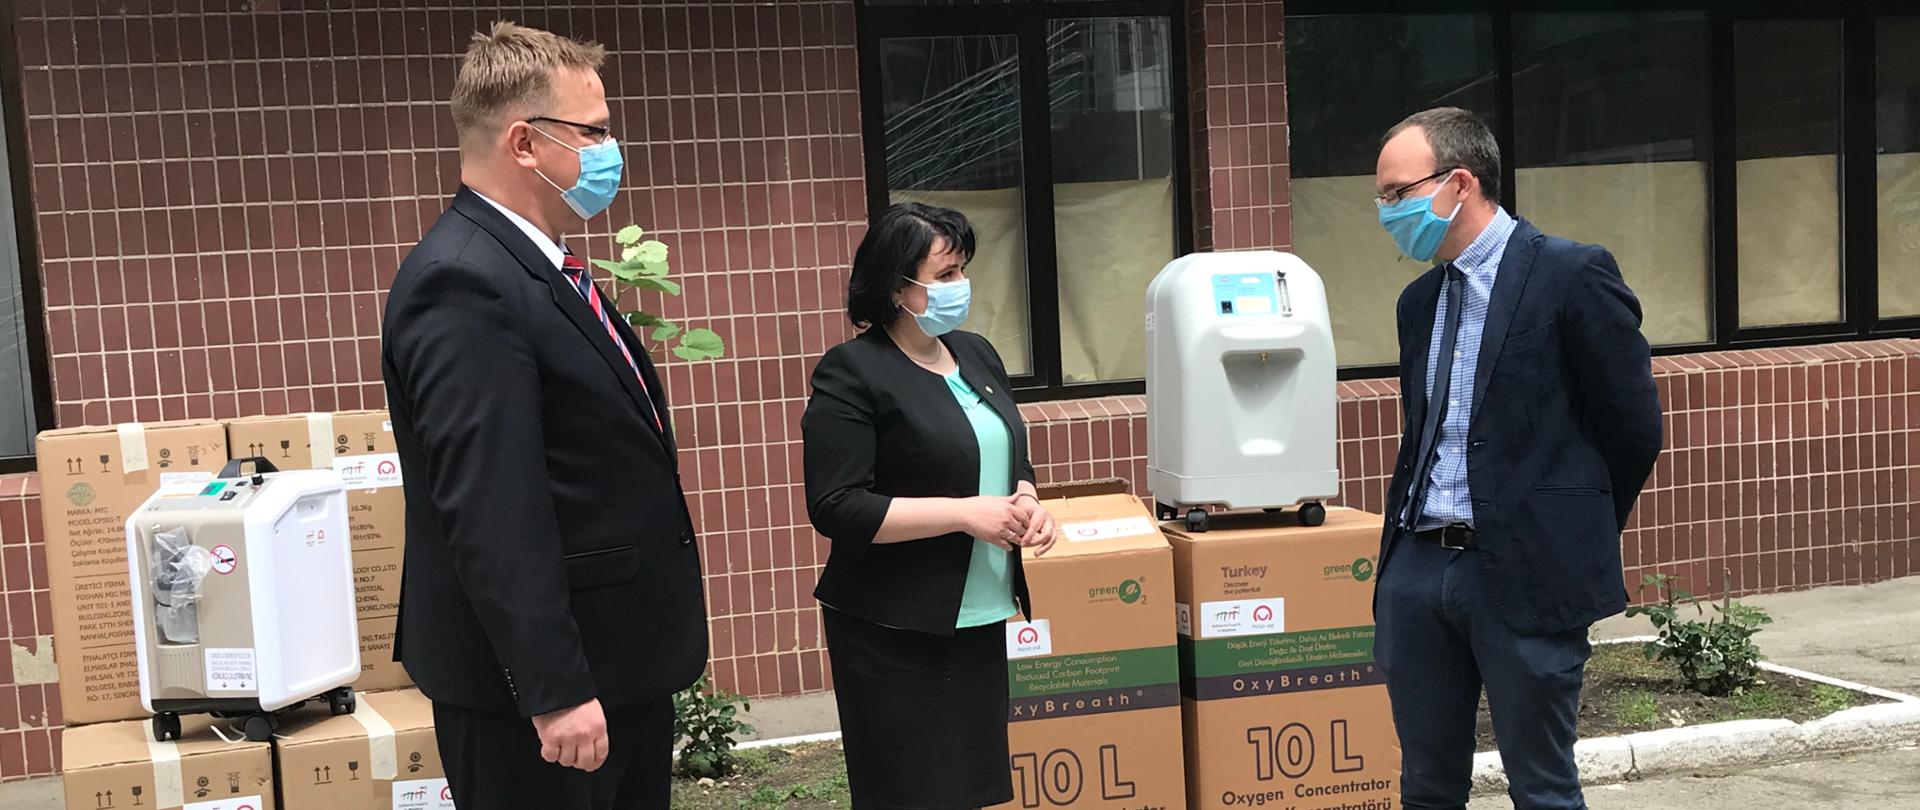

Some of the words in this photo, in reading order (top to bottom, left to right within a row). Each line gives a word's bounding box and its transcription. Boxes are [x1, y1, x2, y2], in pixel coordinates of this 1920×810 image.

[1221, 565, 1267, 579] Turkey
[1324, 564, 1351, 576] green
[1088, 586, 1119, 598] green
[1234, 586, 1261, 595] potential
[80, 623, 97, 631] PARK
[1017, 661, 1033, 671] Low
[1035, 660, 1062, 670] Energy
[1064, 654, 1118, 668] Consumption
[1015, 672, 1050, 682] Reduced
[1052, 668, 1083, 679] Carbon
[1085, 665, 1120, 676] Footprint
[1233, 669, 1360, 692] OxyBreath
[1029, 680, 1070, 692] Recyclable
[1072, 676, 1108, 687] Materials
[1247, 722, 1315, 781] 10
[1330, 719, 1363, 773] L
[1011, 748, 1083, 808] 10
[1099, 744, 1136, 800] L
[1222, 790, 1284, 806] Oxygen
[1294, 778, 1391, 798] Concentrator
